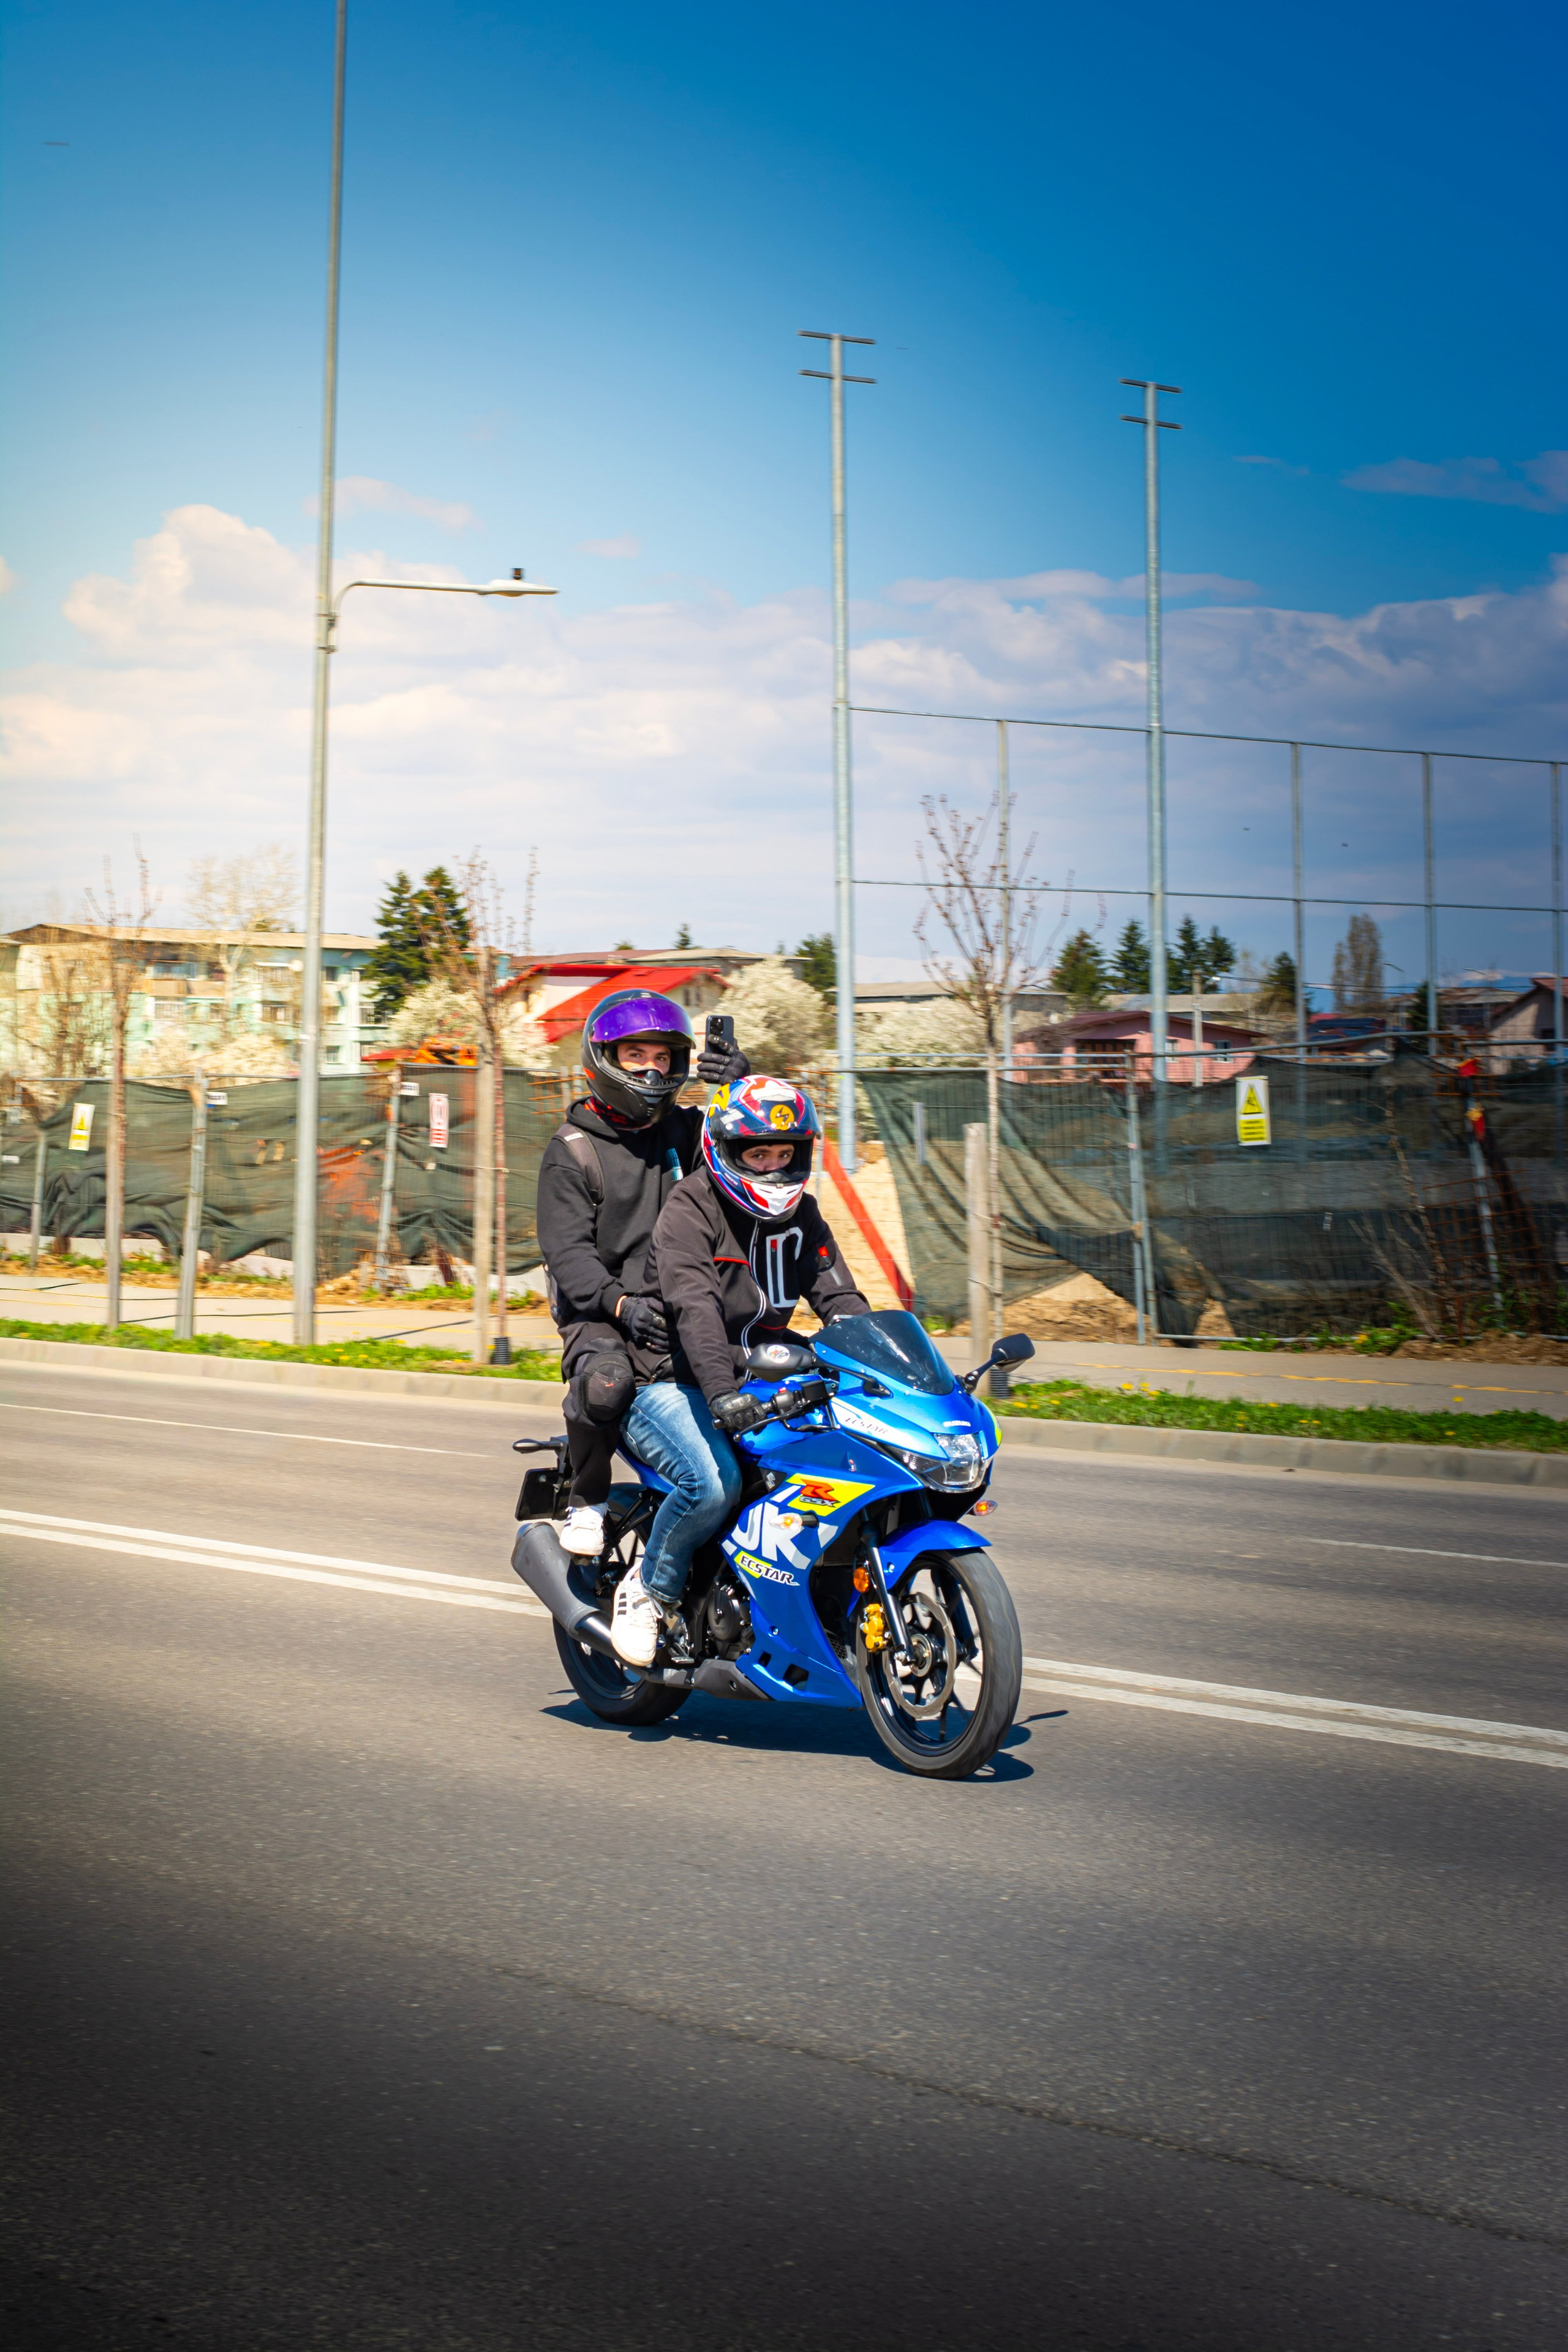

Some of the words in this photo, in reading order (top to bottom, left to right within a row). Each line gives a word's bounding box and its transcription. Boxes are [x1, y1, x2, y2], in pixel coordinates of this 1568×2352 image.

[801, 1479, 837, 1501] R
[799, 1496, 840, 1507] GSX
[741, 1555, 799, 1586] ECSTAR
